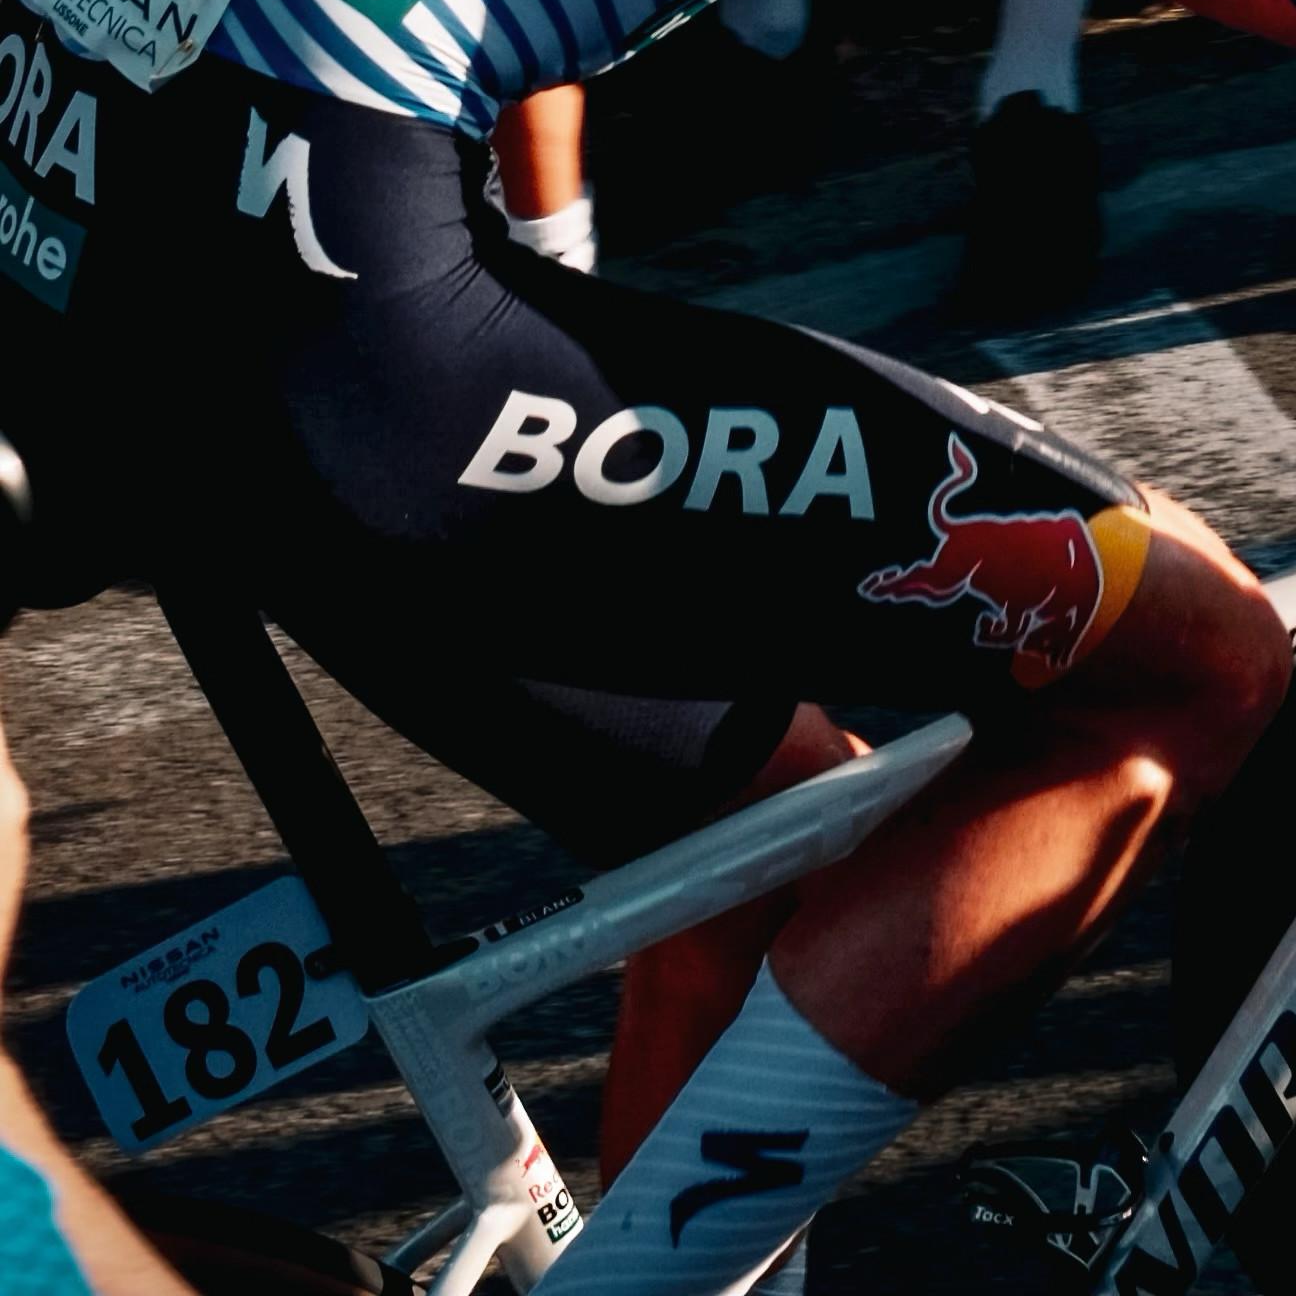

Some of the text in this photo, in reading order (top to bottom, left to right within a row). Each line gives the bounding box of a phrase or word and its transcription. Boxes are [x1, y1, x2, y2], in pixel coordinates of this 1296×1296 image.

[456, 388, 877, 522] BORA
[120, 926, 221, 989] NISSAN
[97, 941, 338, 1142] 182
